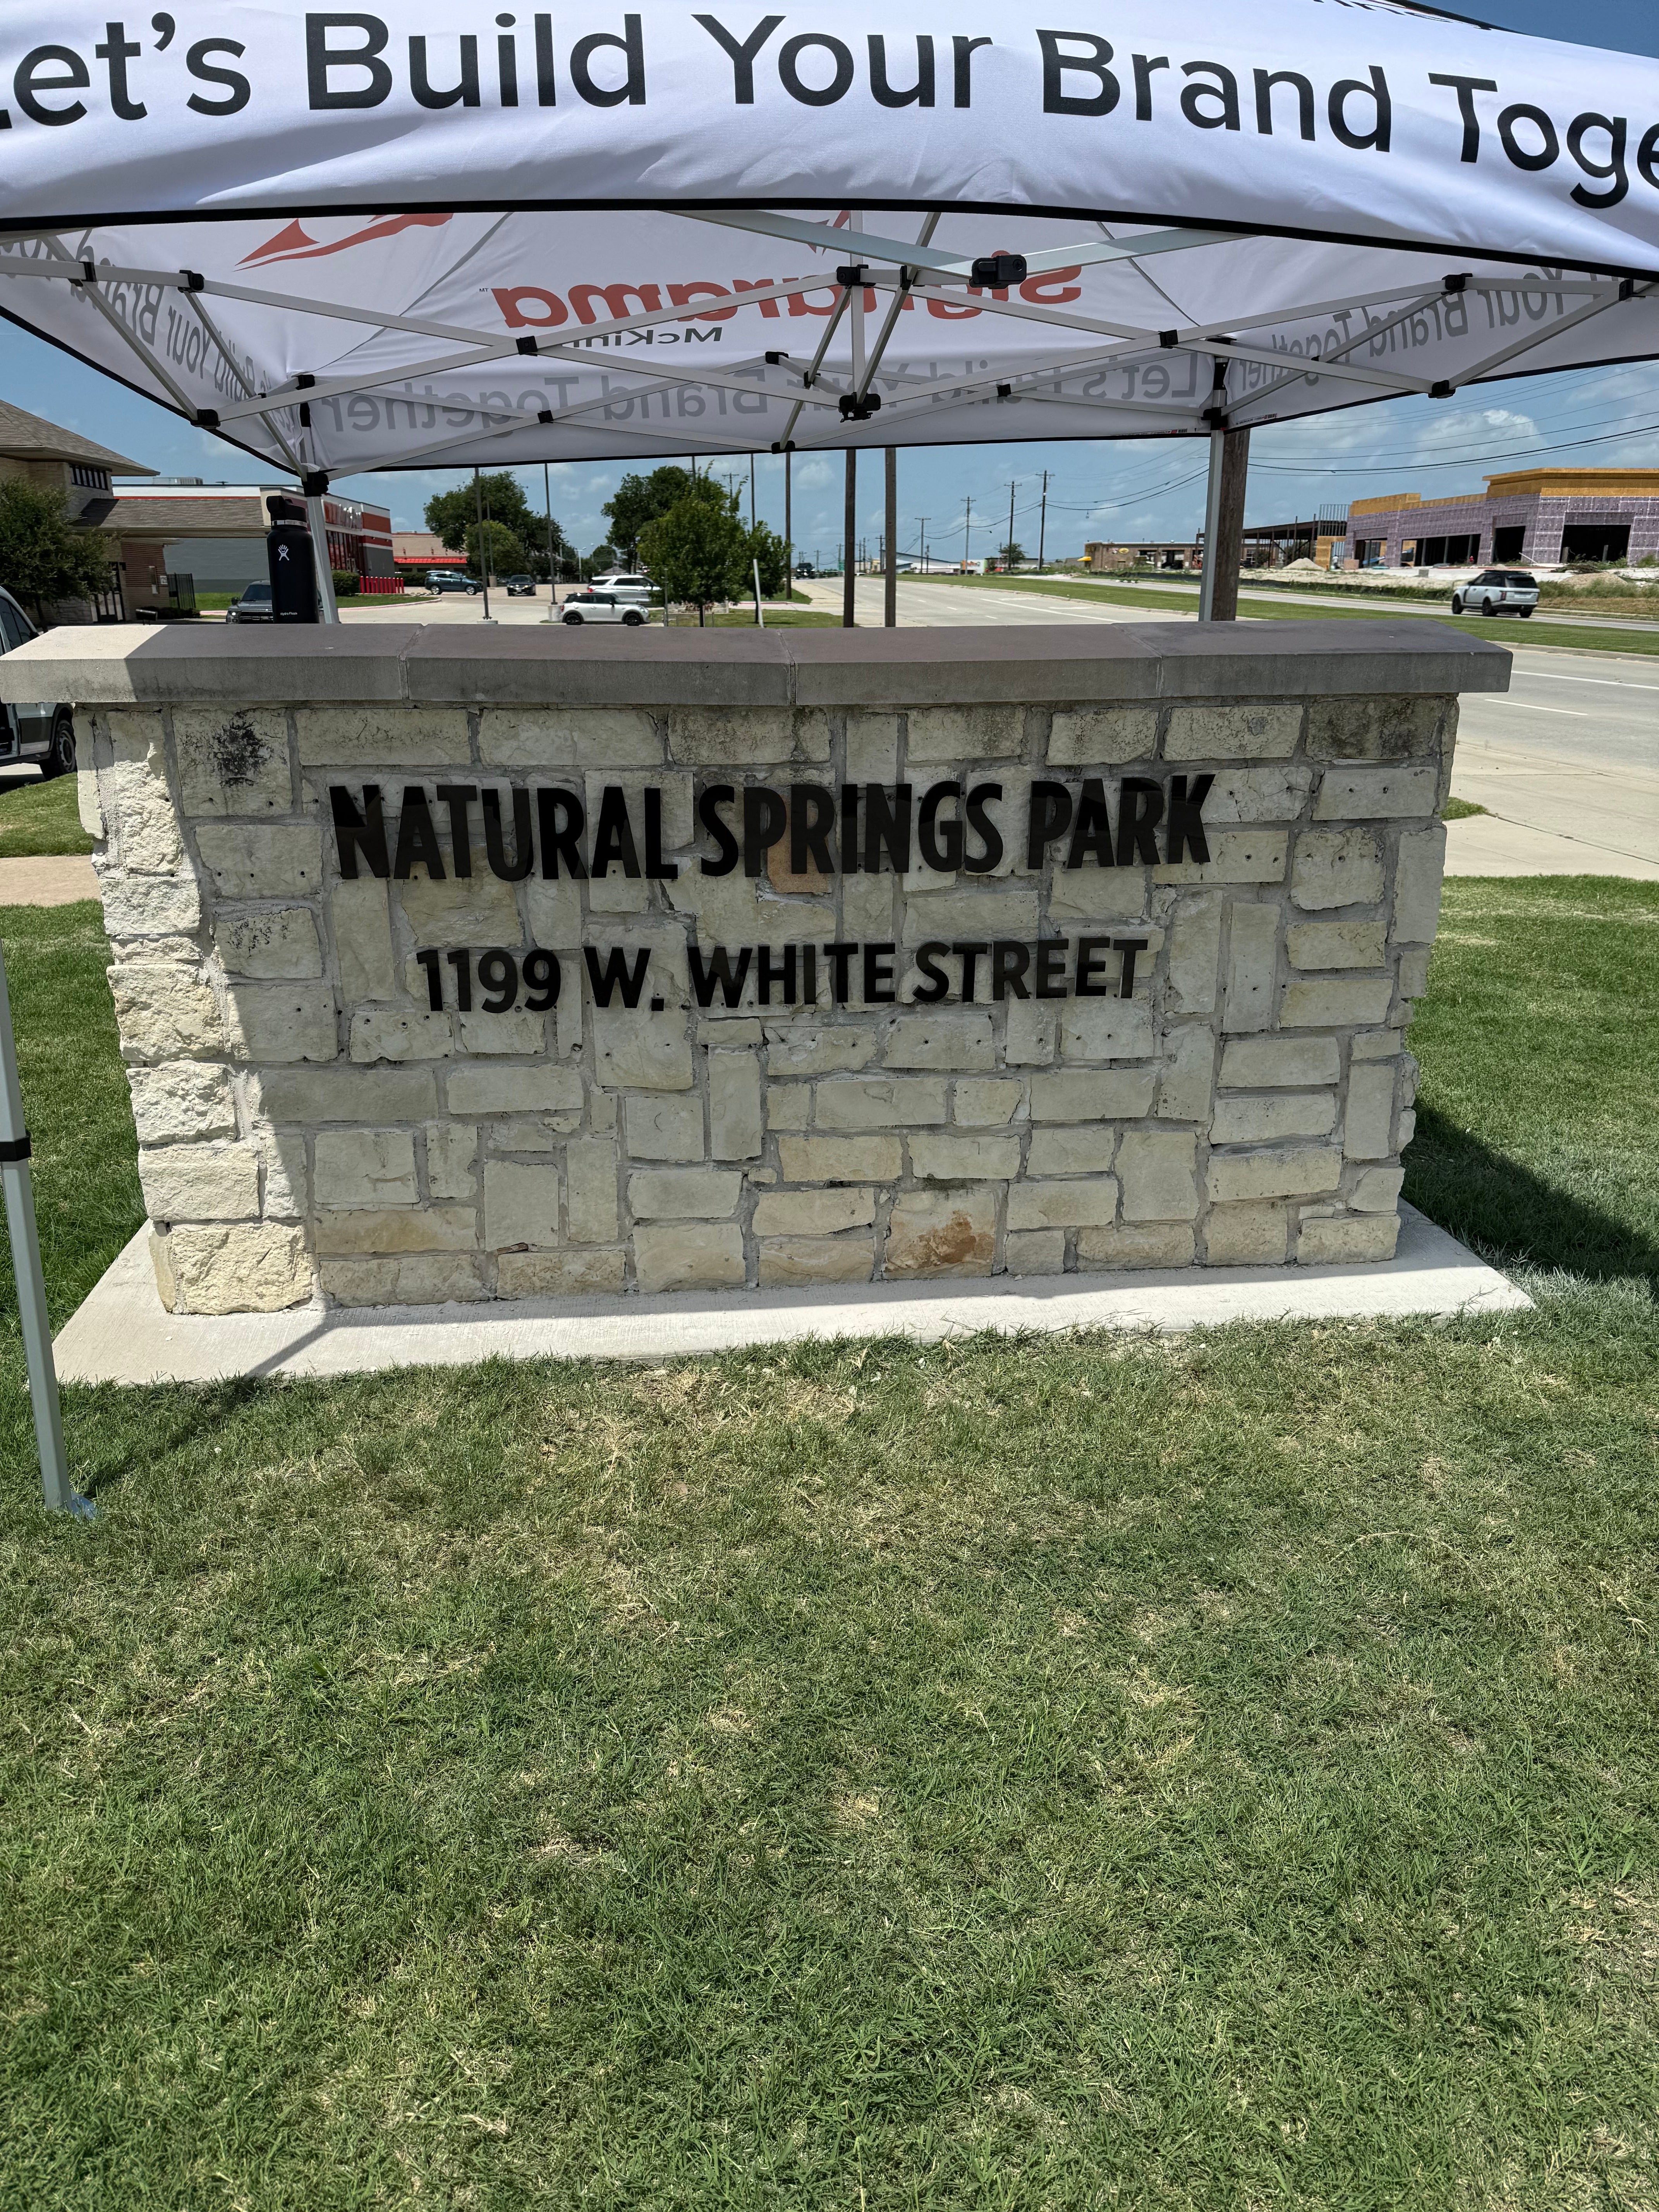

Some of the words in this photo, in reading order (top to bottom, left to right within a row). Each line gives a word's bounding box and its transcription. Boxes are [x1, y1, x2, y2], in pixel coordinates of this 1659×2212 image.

[0, 12, 251, 129] et's
[306, 13, 646, 110] Build
[690, 14, 993, 108] Your
[1036, 29, 1392, 153] Brand
[329, 785, 678, 882] NATURAL
[699, 780, 1004, 878] SPRINGS
[1027, 775, 1216, 870] PARK
[416, 948, 561, 1013] 1199
[584, 946, 664, 1012] W.
[687, 942, 896, 1008] WHITE
[912, 936, 1148, 1003] STREET
